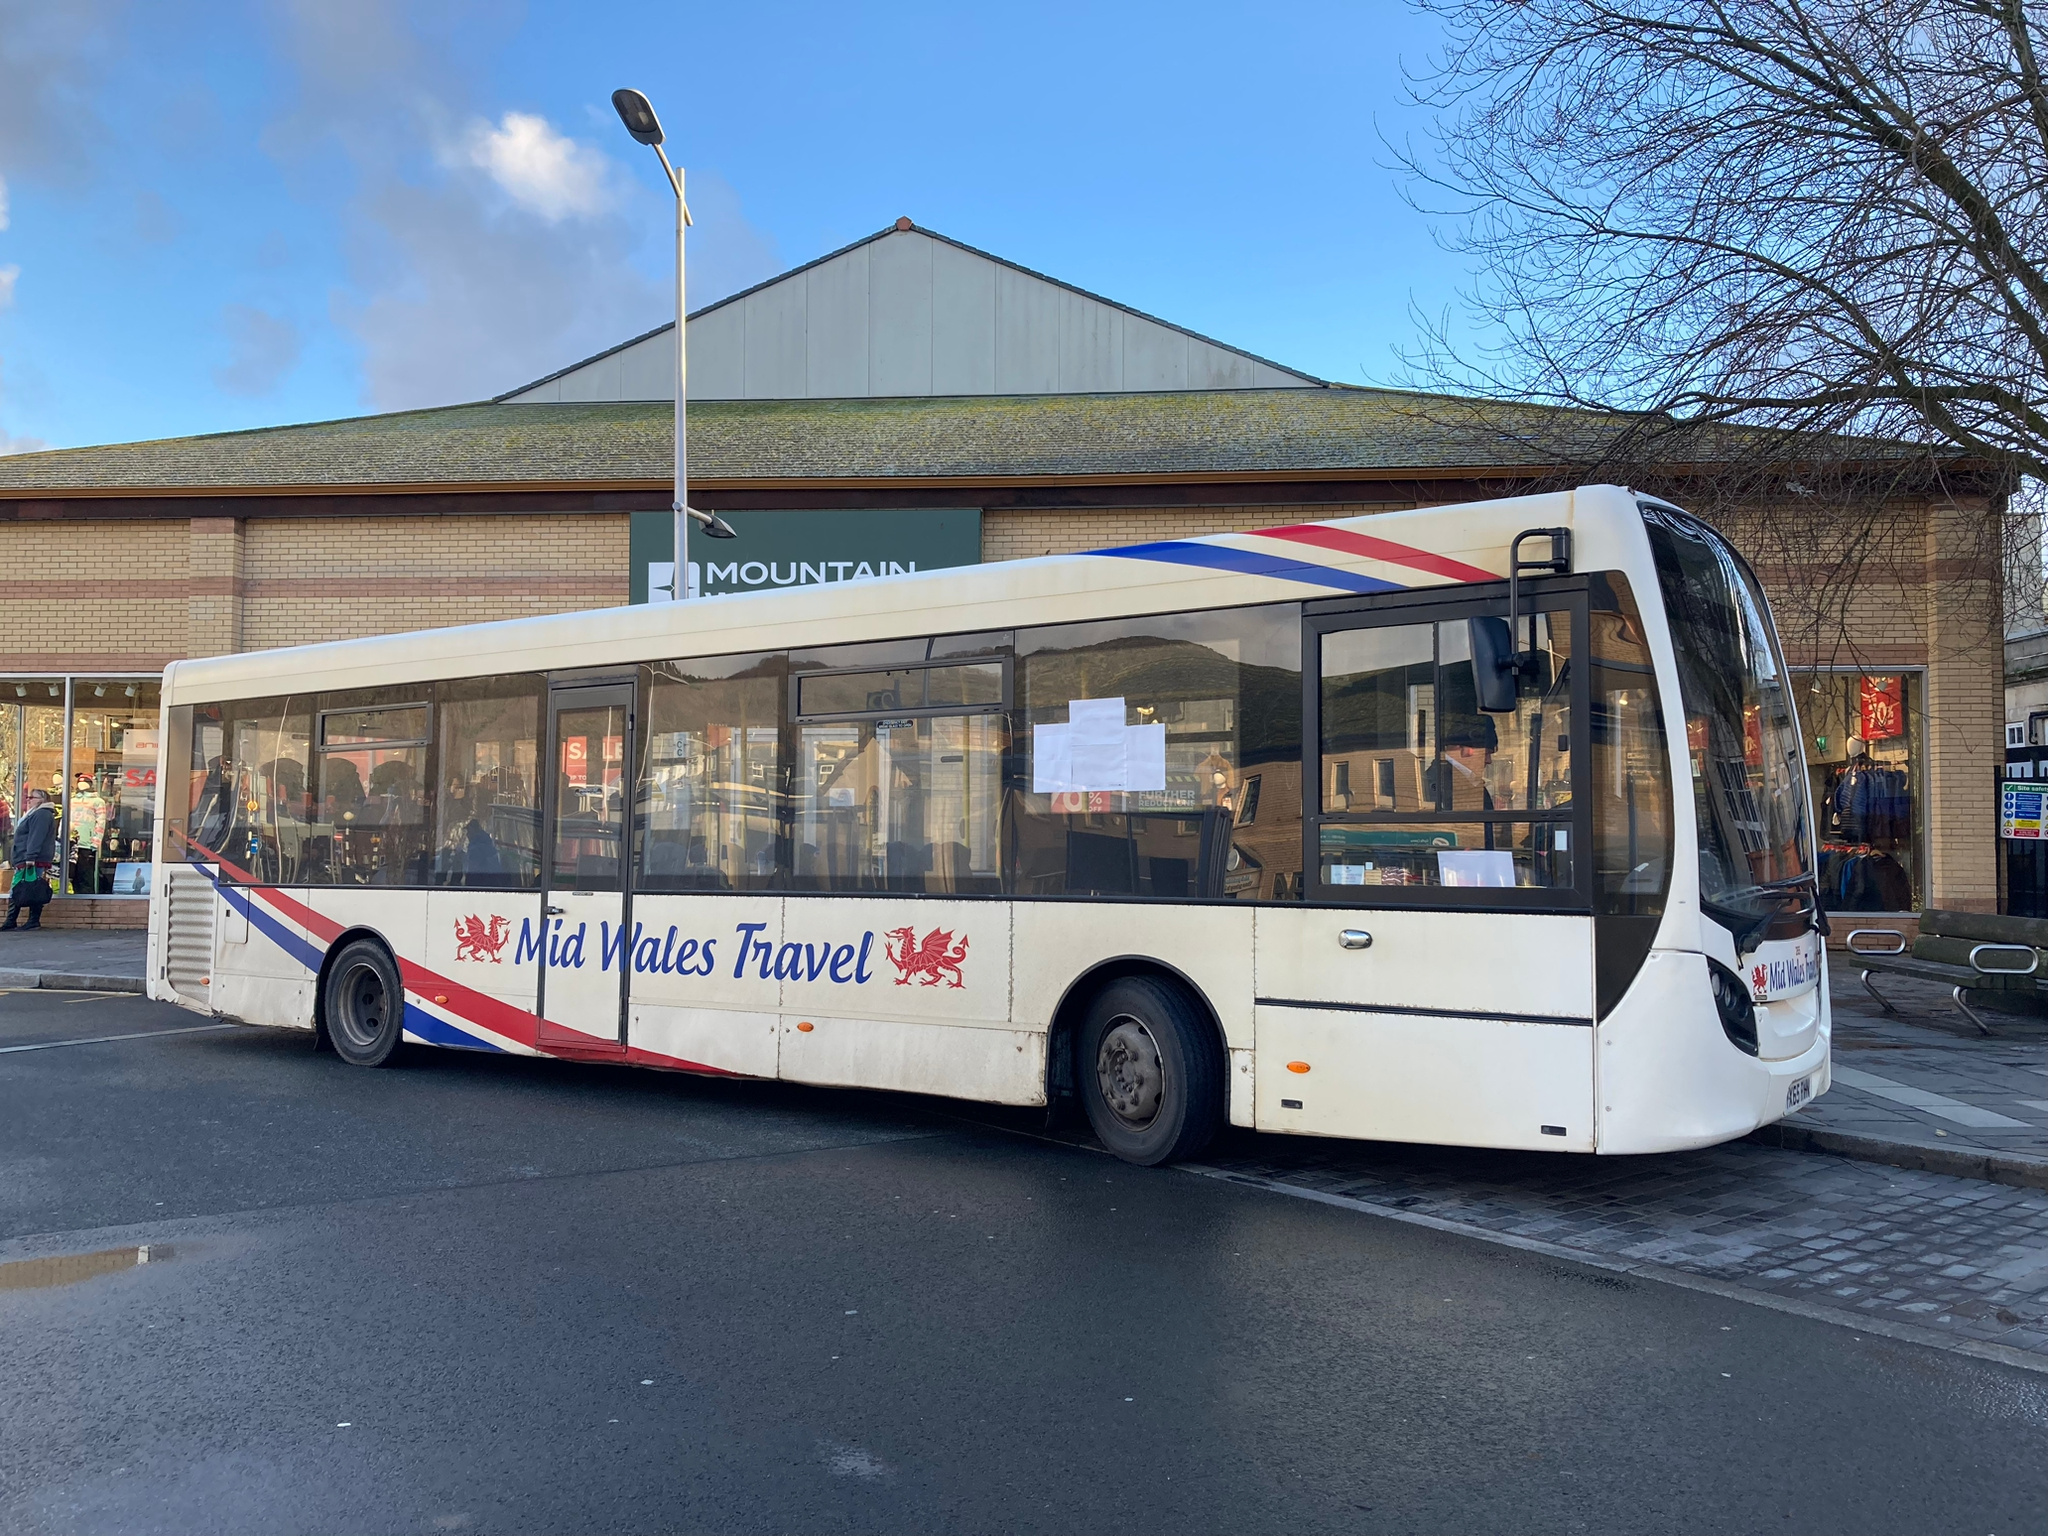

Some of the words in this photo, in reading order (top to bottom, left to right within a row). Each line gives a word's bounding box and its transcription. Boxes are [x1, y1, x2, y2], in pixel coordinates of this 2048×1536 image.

[1138, 790, 1195, 800] FURTHER
[515, 917, 586, 969] Mid
[600, 920, 717, 977] Wales
[733, 922, 875, 984] Travel
[1769, 961, 1786, 992] Mid
[1786, 958, 1805, 988] Wales
